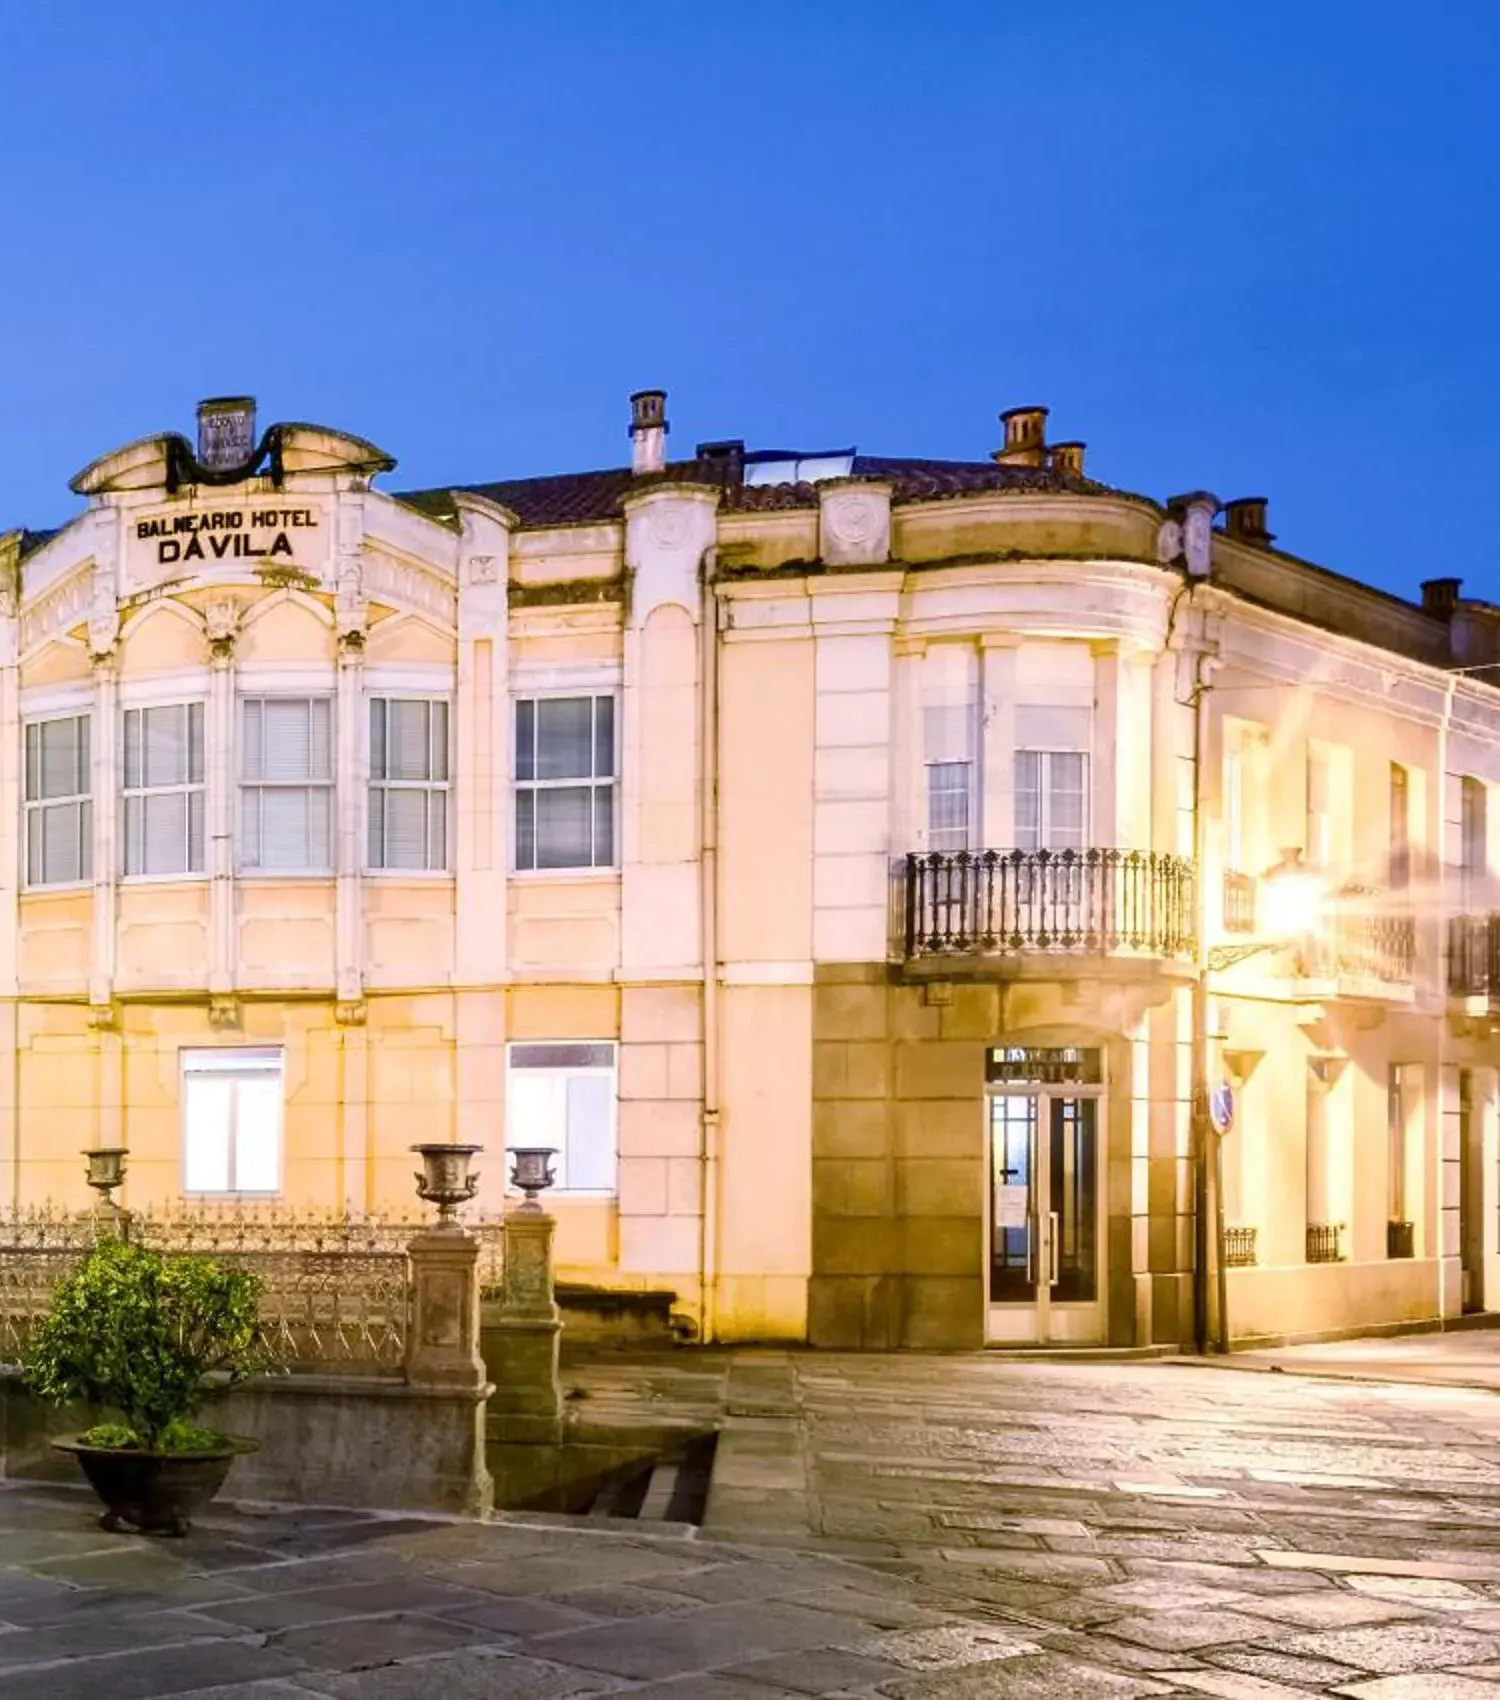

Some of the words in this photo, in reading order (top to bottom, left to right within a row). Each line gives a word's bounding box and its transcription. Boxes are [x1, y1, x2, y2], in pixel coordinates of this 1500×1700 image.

[137, 511, 243, 539] BALNEARIO
[250, 509, 319, 529] HOTEL
[157, 527, 294, 564] DÁVILA
